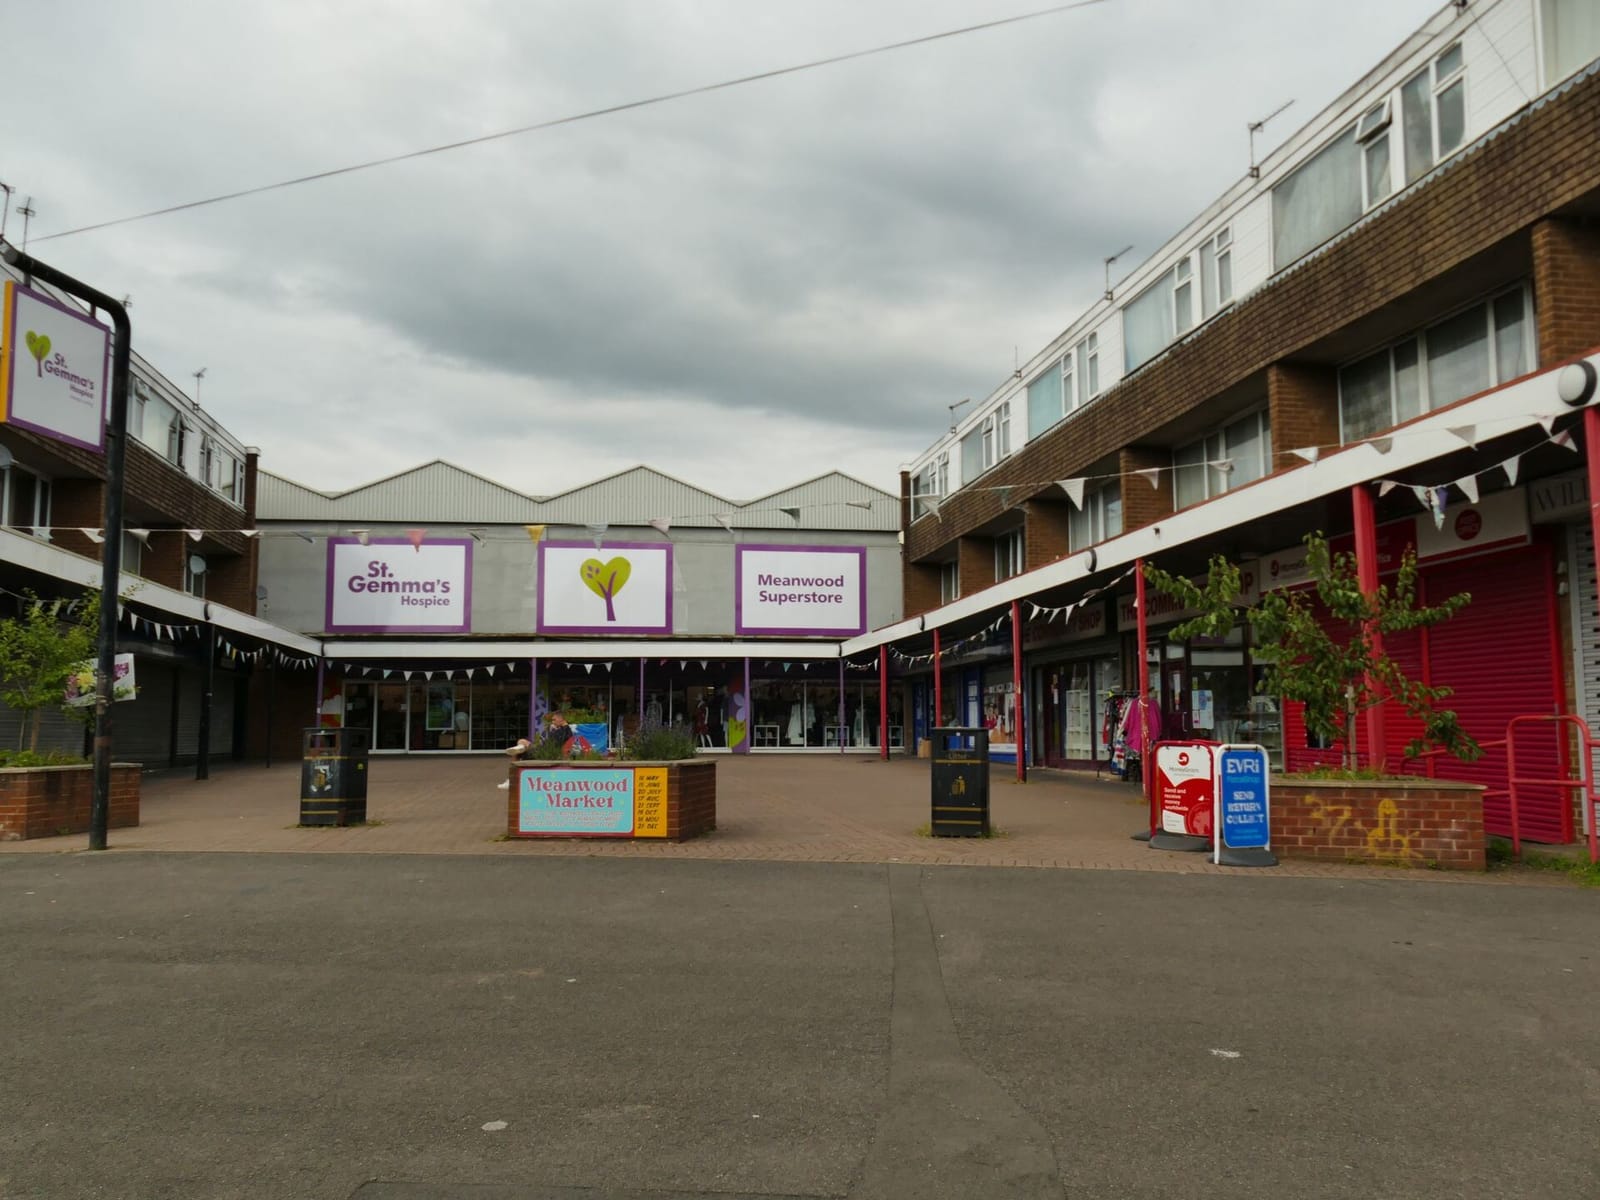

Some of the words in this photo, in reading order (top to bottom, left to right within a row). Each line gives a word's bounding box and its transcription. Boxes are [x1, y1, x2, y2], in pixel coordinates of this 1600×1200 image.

[54, 352, 68, 369] St.
[44, 360, 95, 390] Gemma's
[367, 560, 394, 578] St.
[348, 575, 451, 593] Gemma's
[757, 574, 844, 587] Meanwood
[400, 595, 450, 608] Hospice
[759, 590, 843, 605] Superstore
[1226, 758, 1260, 774] EVRi
[527, 777, 628, 792] Meanwood
[546, 793, 614, 808] Market
[1233, 791, 1255, 800] SEND
[1226, 814, 1264, 824] COLLECT
